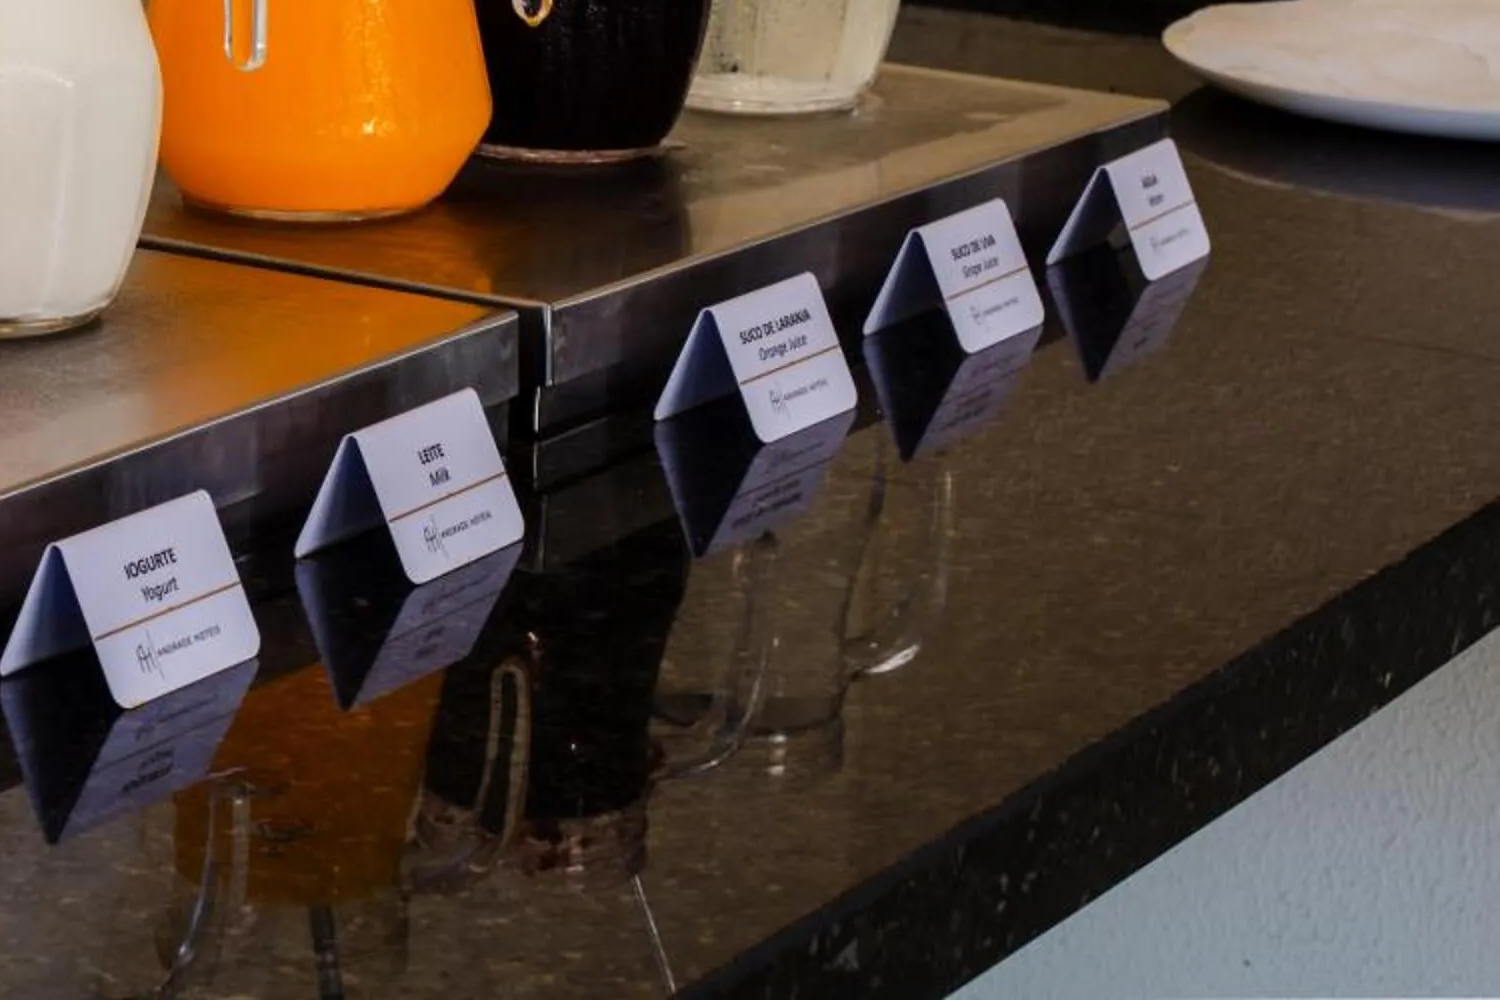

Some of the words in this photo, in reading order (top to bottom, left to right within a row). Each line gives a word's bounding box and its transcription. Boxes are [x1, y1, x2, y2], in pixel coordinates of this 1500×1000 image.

[740, 326, 762, 345] SUCO
[762, 321, 775, 336] DE
[776, 308, 811, 332] LARANJA
[758, 343, 788, 361] Orange
[788, 334, 807, 350] Juice
[417, 443, 445, 465] LEITE
[429, 467, 450, 487] Milk
[124, 547, 178, 580] IOGURTE
[140, 576, 180, 602] Yogurt
